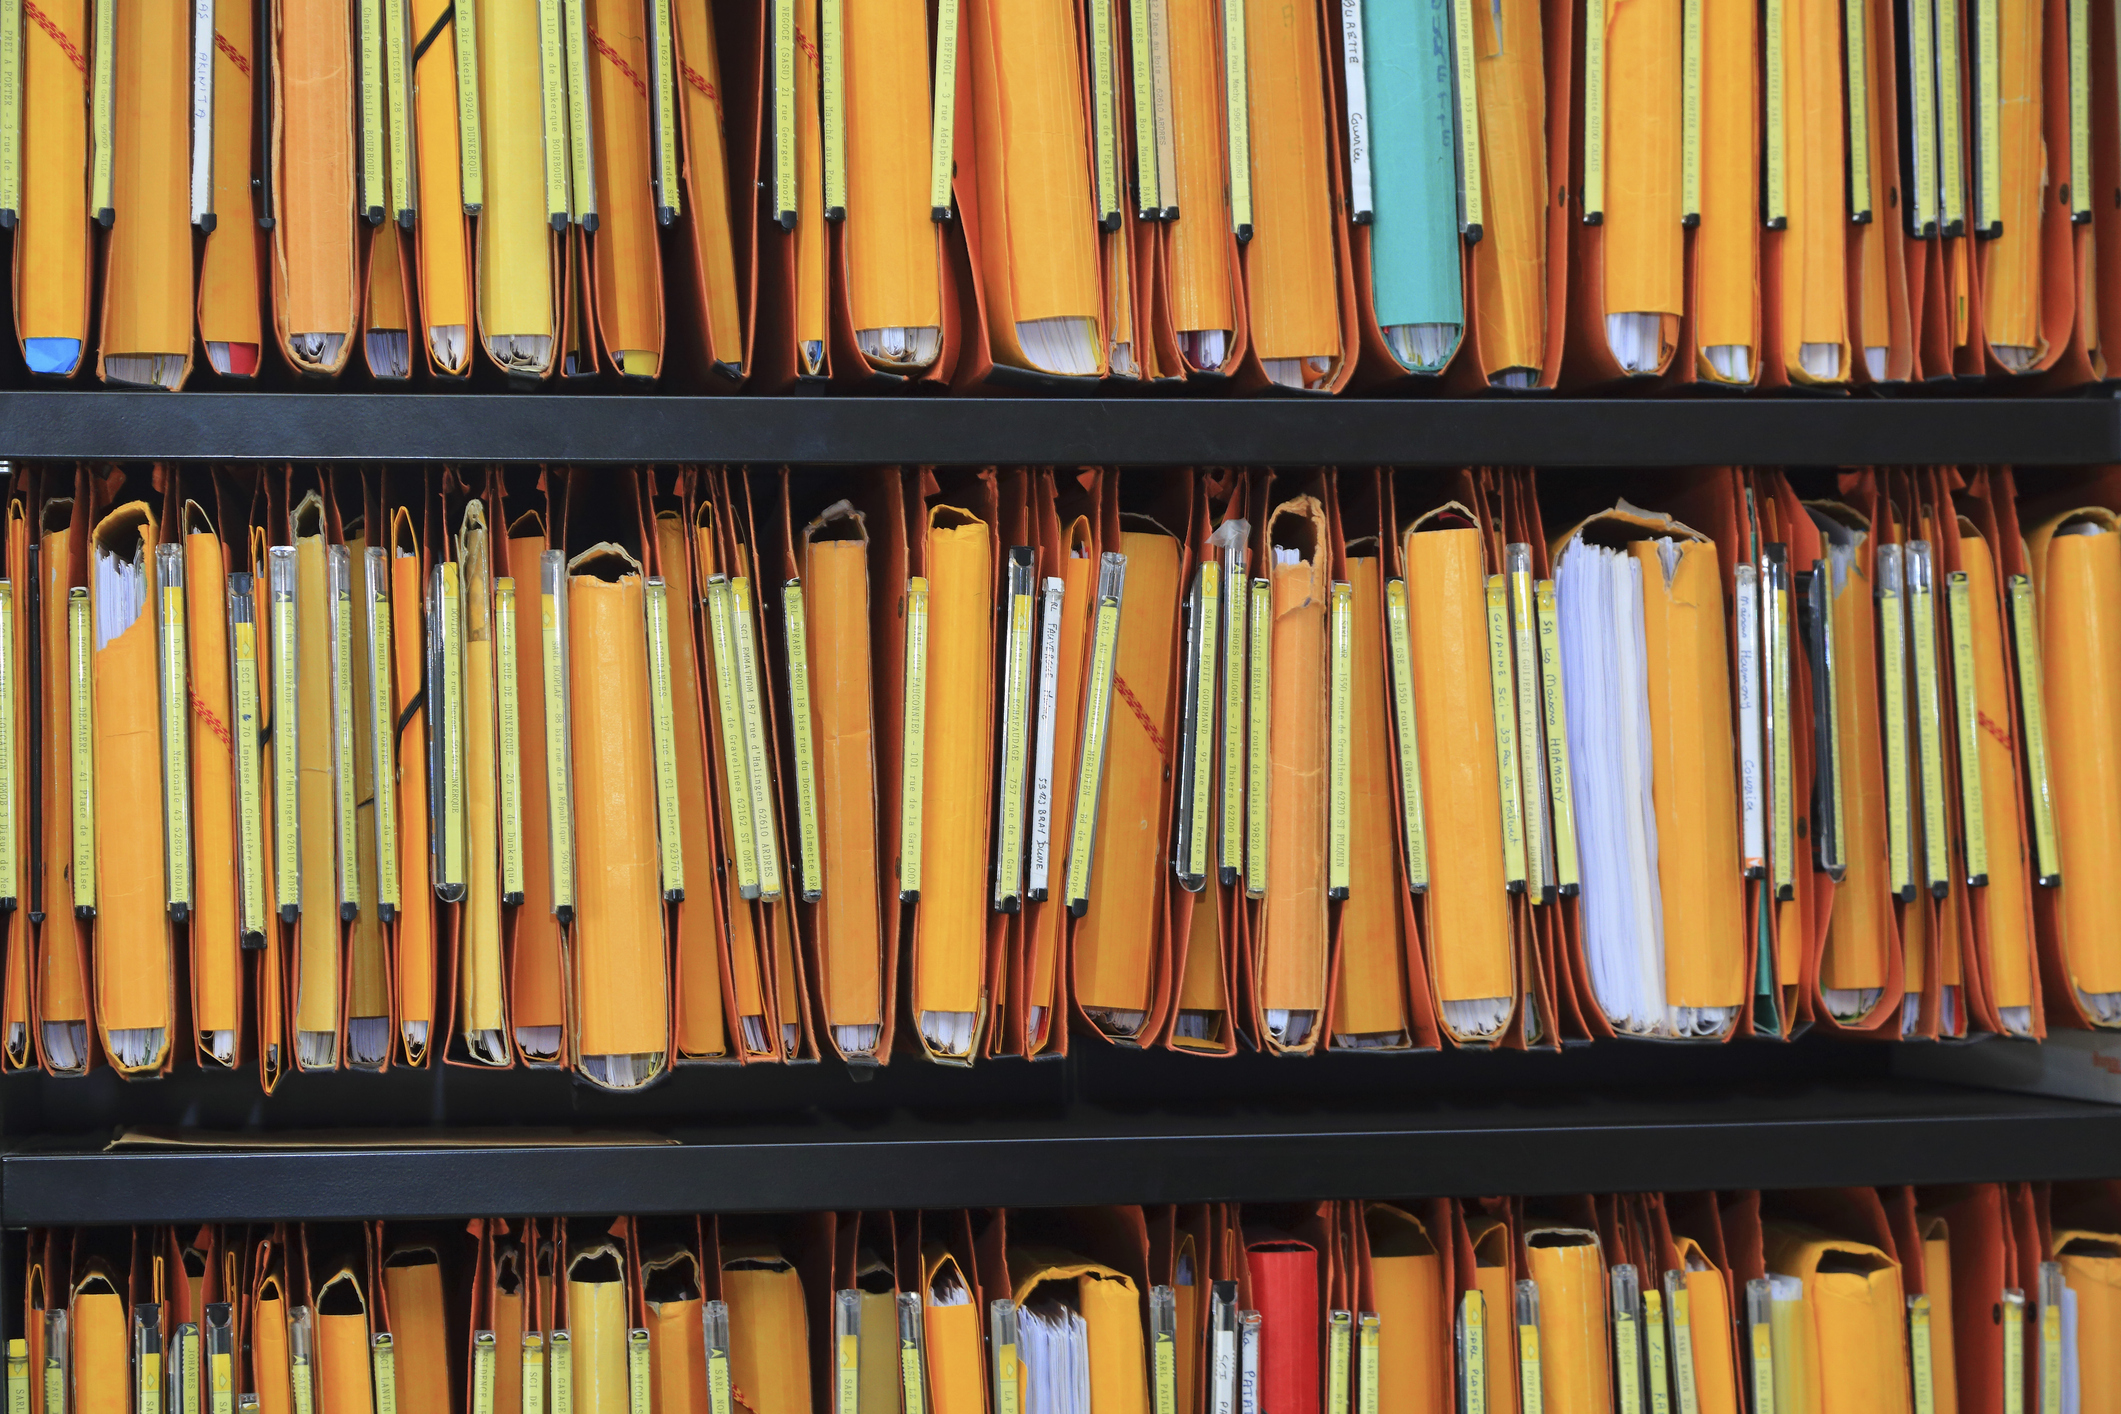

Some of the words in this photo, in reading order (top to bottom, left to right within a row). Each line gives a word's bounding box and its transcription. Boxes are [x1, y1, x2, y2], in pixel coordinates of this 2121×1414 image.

[363, 6, 372, 42] Chemin
[781, 6, 789, 41] NEGOCE
[824, 32, 832, 49] bis
[1151, 12, 1160, 36] Place
[4, 30, 12, 54] PRET
[660, 44, 669, 67] 1625
[943, 36, 953, 76] BEFFROI
[392, 37, 400, 84] OPTICIEN
[780, 47, 790, 81] (SASU)
[824, 55, 832, 83] Place
[1098, 40, 1108, 86] L'EGLISE
[4, 71, 12, 106] PORTER
[364, 83, 373, 123] Babille
[661, 72, 670, 101] route
[1155, 88, 1164, 113] 62610
[1590, 69, 1599, 111] Lafayette
[464, 91, 474, 120] 59240
[548, 81, 559, 132] Dunkerque
[573, 101, 582, 130] 62610
[1233, 107, 1241, 132] 59630
[1461, 45, 1471, 79] BUTTEZ
[1466, 141, 1476, 191] Blanchard
[825, 106, 833, 141] Marché
[1139, 118, 1147, 140] Bois
[1157, 117, 1166, 146] ARDRES
[365, 129, 374, 182] BOURBOURG
[465, 126, 477, 178] DUNKERQUE
[552, 138, 562, 190] BOURBOURG
[575, 136, 584, 171] ARDRES
[664, 142, 674, 183] Bistade
[780, 126, 790, 167] Georges
[937, 127, 949, 167] Adelphe
[1140, 146, 1149, 180] Maurin
[1234, 136, 1243, 179] BOURBOURG
[1102, 142, 1113, 188] l'Eglise
[1204, 608, 1212, 632] SARL
[1542, 620, 1554, 635] SA
[340, 609, 350, 691] DISTRIBOISSONS
[1232, 627, 1240, 656] SHOES
[794, 661, 804, 691] MEROU
[1202, 654, 1211, 682] PETIT
[1230, 662, 1239, 708] BOULOGNE
[1253, 667, 1261, 702] HERANT
[1493, 613, 1507, 677] GUYANNE
[1500, 728, 1511, 744] 39
[1521, 659, 1531, 704] GUIJERIS
[1740, 650, 1752, 710] Harmony
[284, 668, 293, 704] DRYADE
[1545, 674, 1559, 726] Maisons
[911, 677, 921, 734] FAUCONNIER
[1200, 688, 1210, 735] GOURMAND
[1338, 696, 1347, 719] route
[502, 703, 513, 756] DUNKERQUE
[1010, 698, 1021, 762] ECHAFAUDAGE
[1252, 730, 1260, 758] route
[241, 744, 252, 784] Impasse
[729, 734, 743, 792] Gravelines
[741, 646, 754, 693] EMMATHOM
[750, 745, 765, 802] d'Halingen
[761, 843, 773, 878] ARDRES
[1337, 738, 1346, 787] Gravelines
[1393, 619, 1403, 642] SARL
[1400, 710, 1410, 734] route
[1409, 840, 1422, 879] FOLQUIN
[344, 762, 352, 784] Pont
[1009, 778, 1018, 795] 757
[1082, 750, 1095, 796] MERIDIEN
[1228, 765, 1236, 799] Thiers
[1525, 766, 1534, 795] Louis
[1550, 738, 1565, 804] HARMONY
[79, 789, 87, 818] Place
[284, 768, 294, 827] d'Halingen
[450, 769, 459, 814] DUNKERQUE
[802, 778, 812, 817] Docteur
[1251, 781, 1259, 815] Calais
[345, 809, 353, 843] Pierre
[556, 796, 568, 845] République
[666, 796, 677, 836] Leclerc
[736, 798, 747, 827] 62162
[1037, 809, 1047, 835] BRAY
[1527, 800, 1536, 840] Braille
[244, 808, 254, 861] Cimetière
[286, 833, 295, 863] 62610
[805, 824, 816, 870] Calmette
[908, 832, 916, 856] Gare
[1334, 833, 1344, 868] FOLQUIN
[78, 842, 88, 890] l'Eglise
[505, 832, 516, 884] Dunkerque
[560, 850, 569, 875] 59430
[669, 842, 680, 872] 62370
[741, 850, 752, 873] OMER
[1068, 848, 1084, 893] l'Europe
[245, 867, 255, 908] chinois
[187, 1348, 195, 1389] JOHANES
[528, 1371, 537, 1389] SCI
[714, 1369, 724, 1393] SARL
[906, 1359, 916, 1382] SASU
[1158, 1354, 1167, 1378] SARL
[1335, 1359, 1343, 1376] SCI
[1366, 1358, 1376, 1381] SARL
[16, 1389, 24, 1413] SARL
[51, 1380, 59, 1405] SARL
[298, 1373, 306, 1397] SARL
[529, 1395, 538, 1408] DE
[557, 1377, 567, 1413] GARAGE
[844, 1378, 853, 1403] SARL
[908, 1388, 917, 1400] LE
[1004, 1390, 1013, 1402] LA
[188, 1396, 196, 1413] SCI
